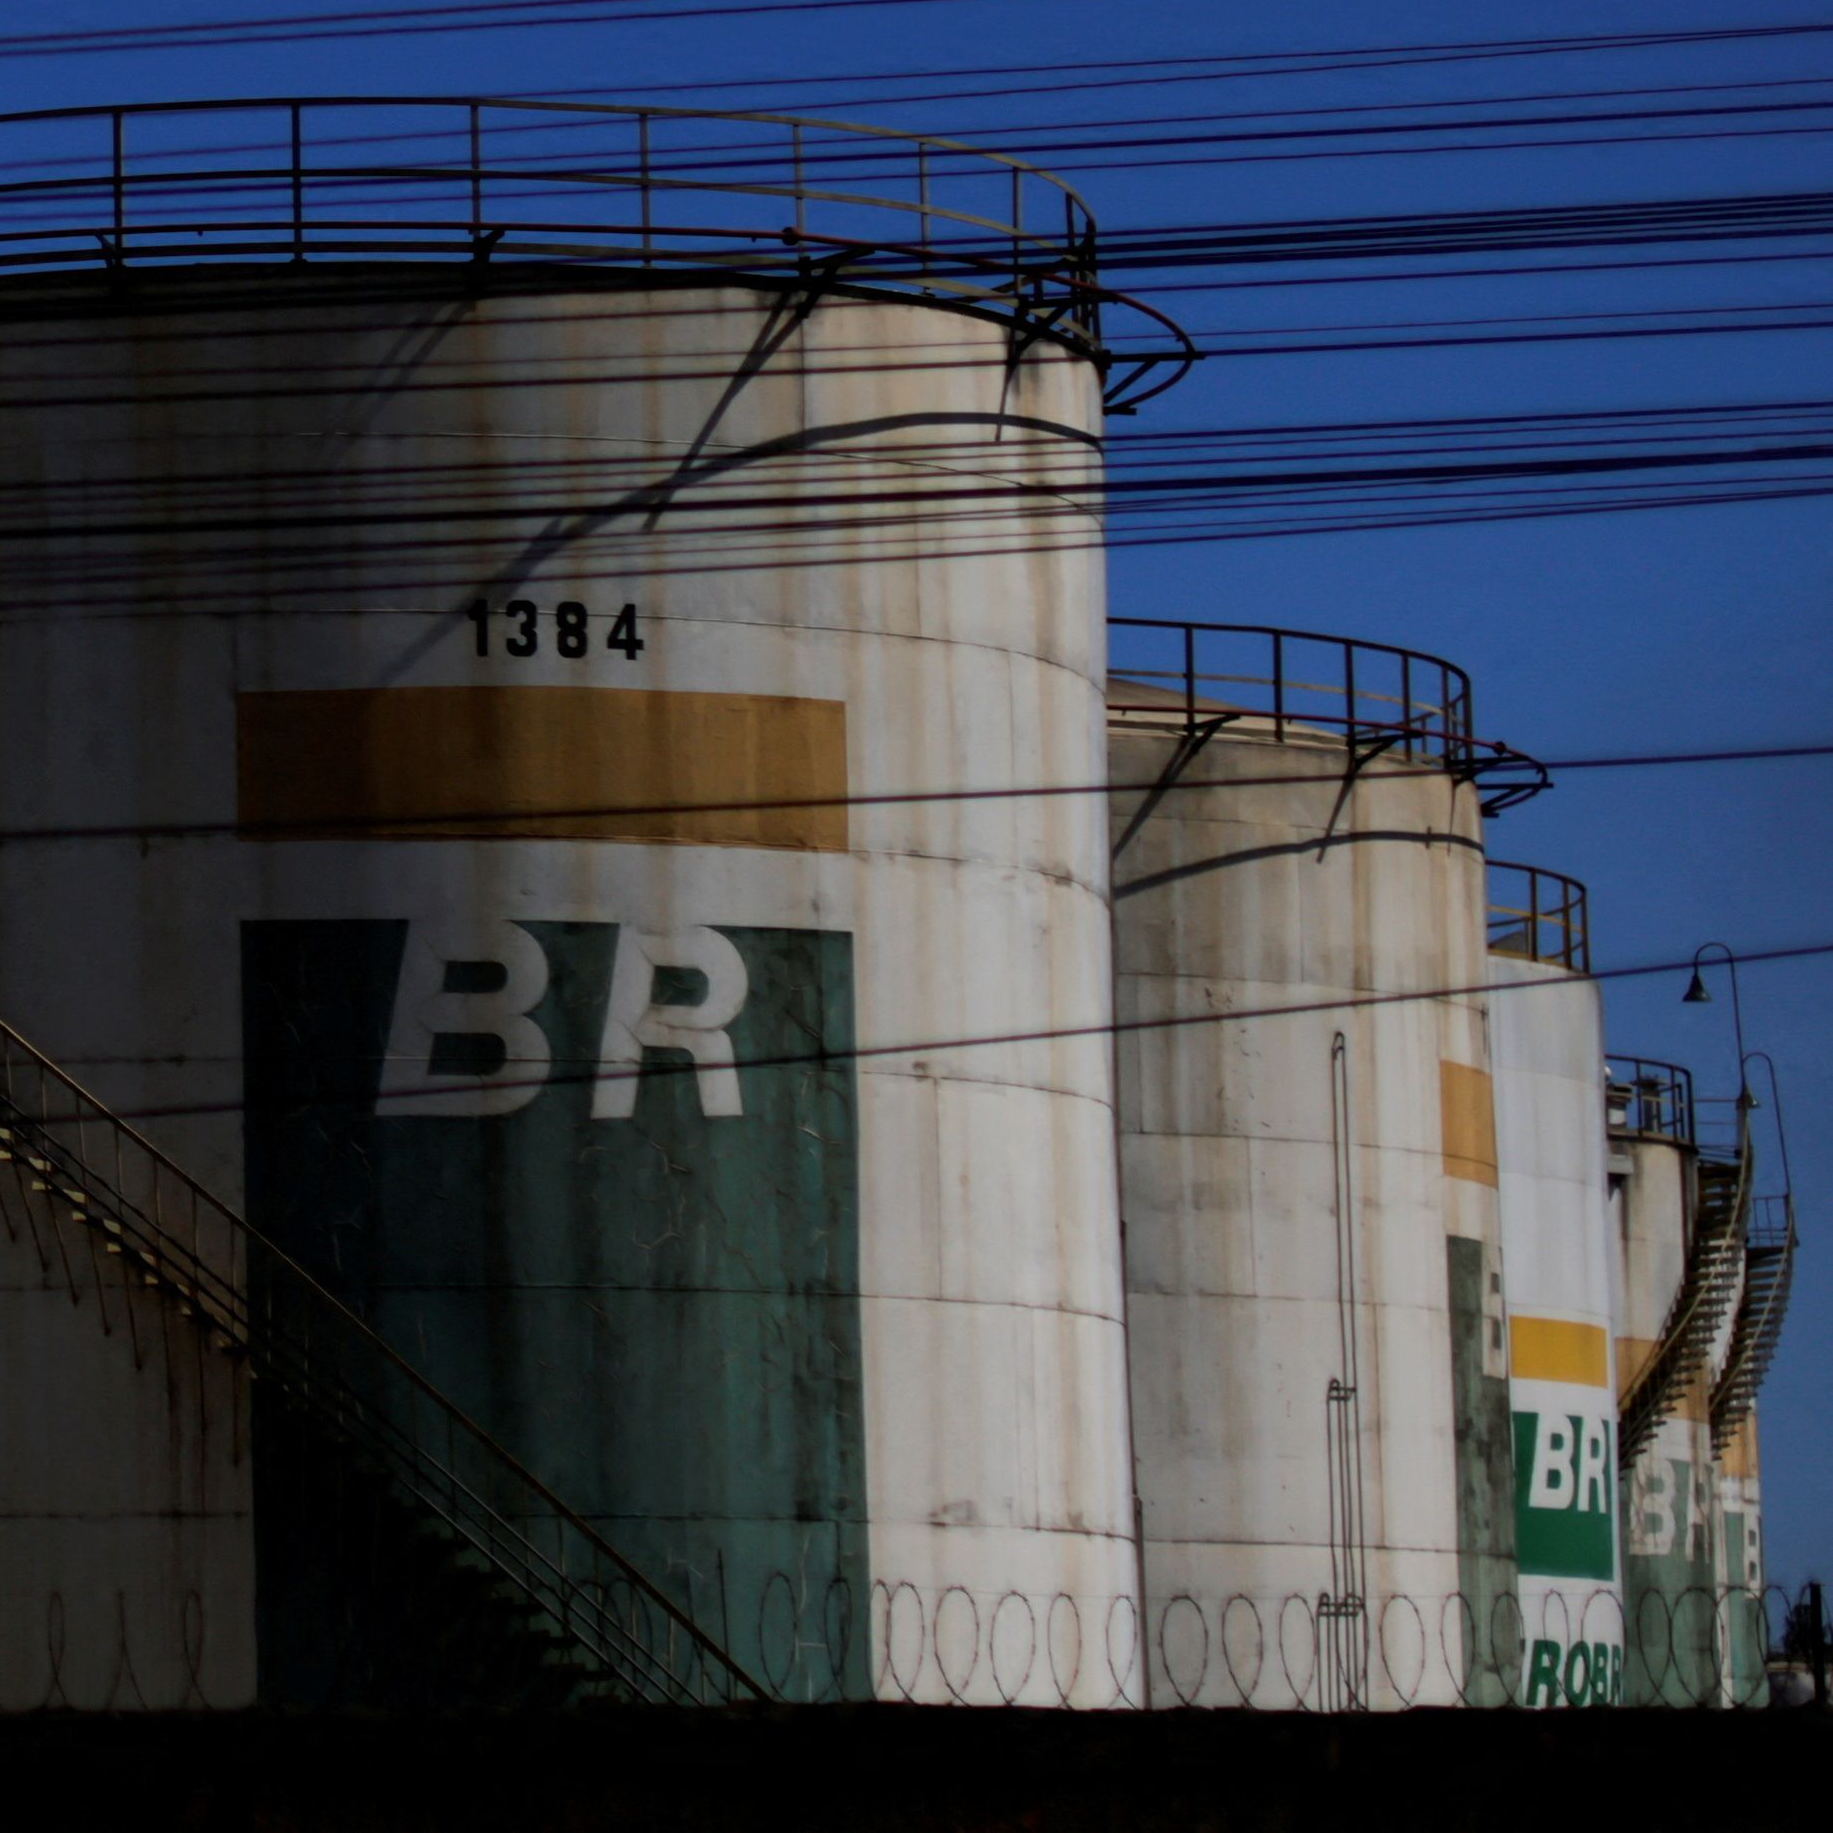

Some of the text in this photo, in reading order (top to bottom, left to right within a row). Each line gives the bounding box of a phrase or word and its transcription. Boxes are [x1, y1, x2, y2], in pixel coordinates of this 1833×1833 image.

[469, 599, 644, 660] 1384
[374, 919, 749, 1119] BR
[1528, 1414, 1607, 1514] BR
